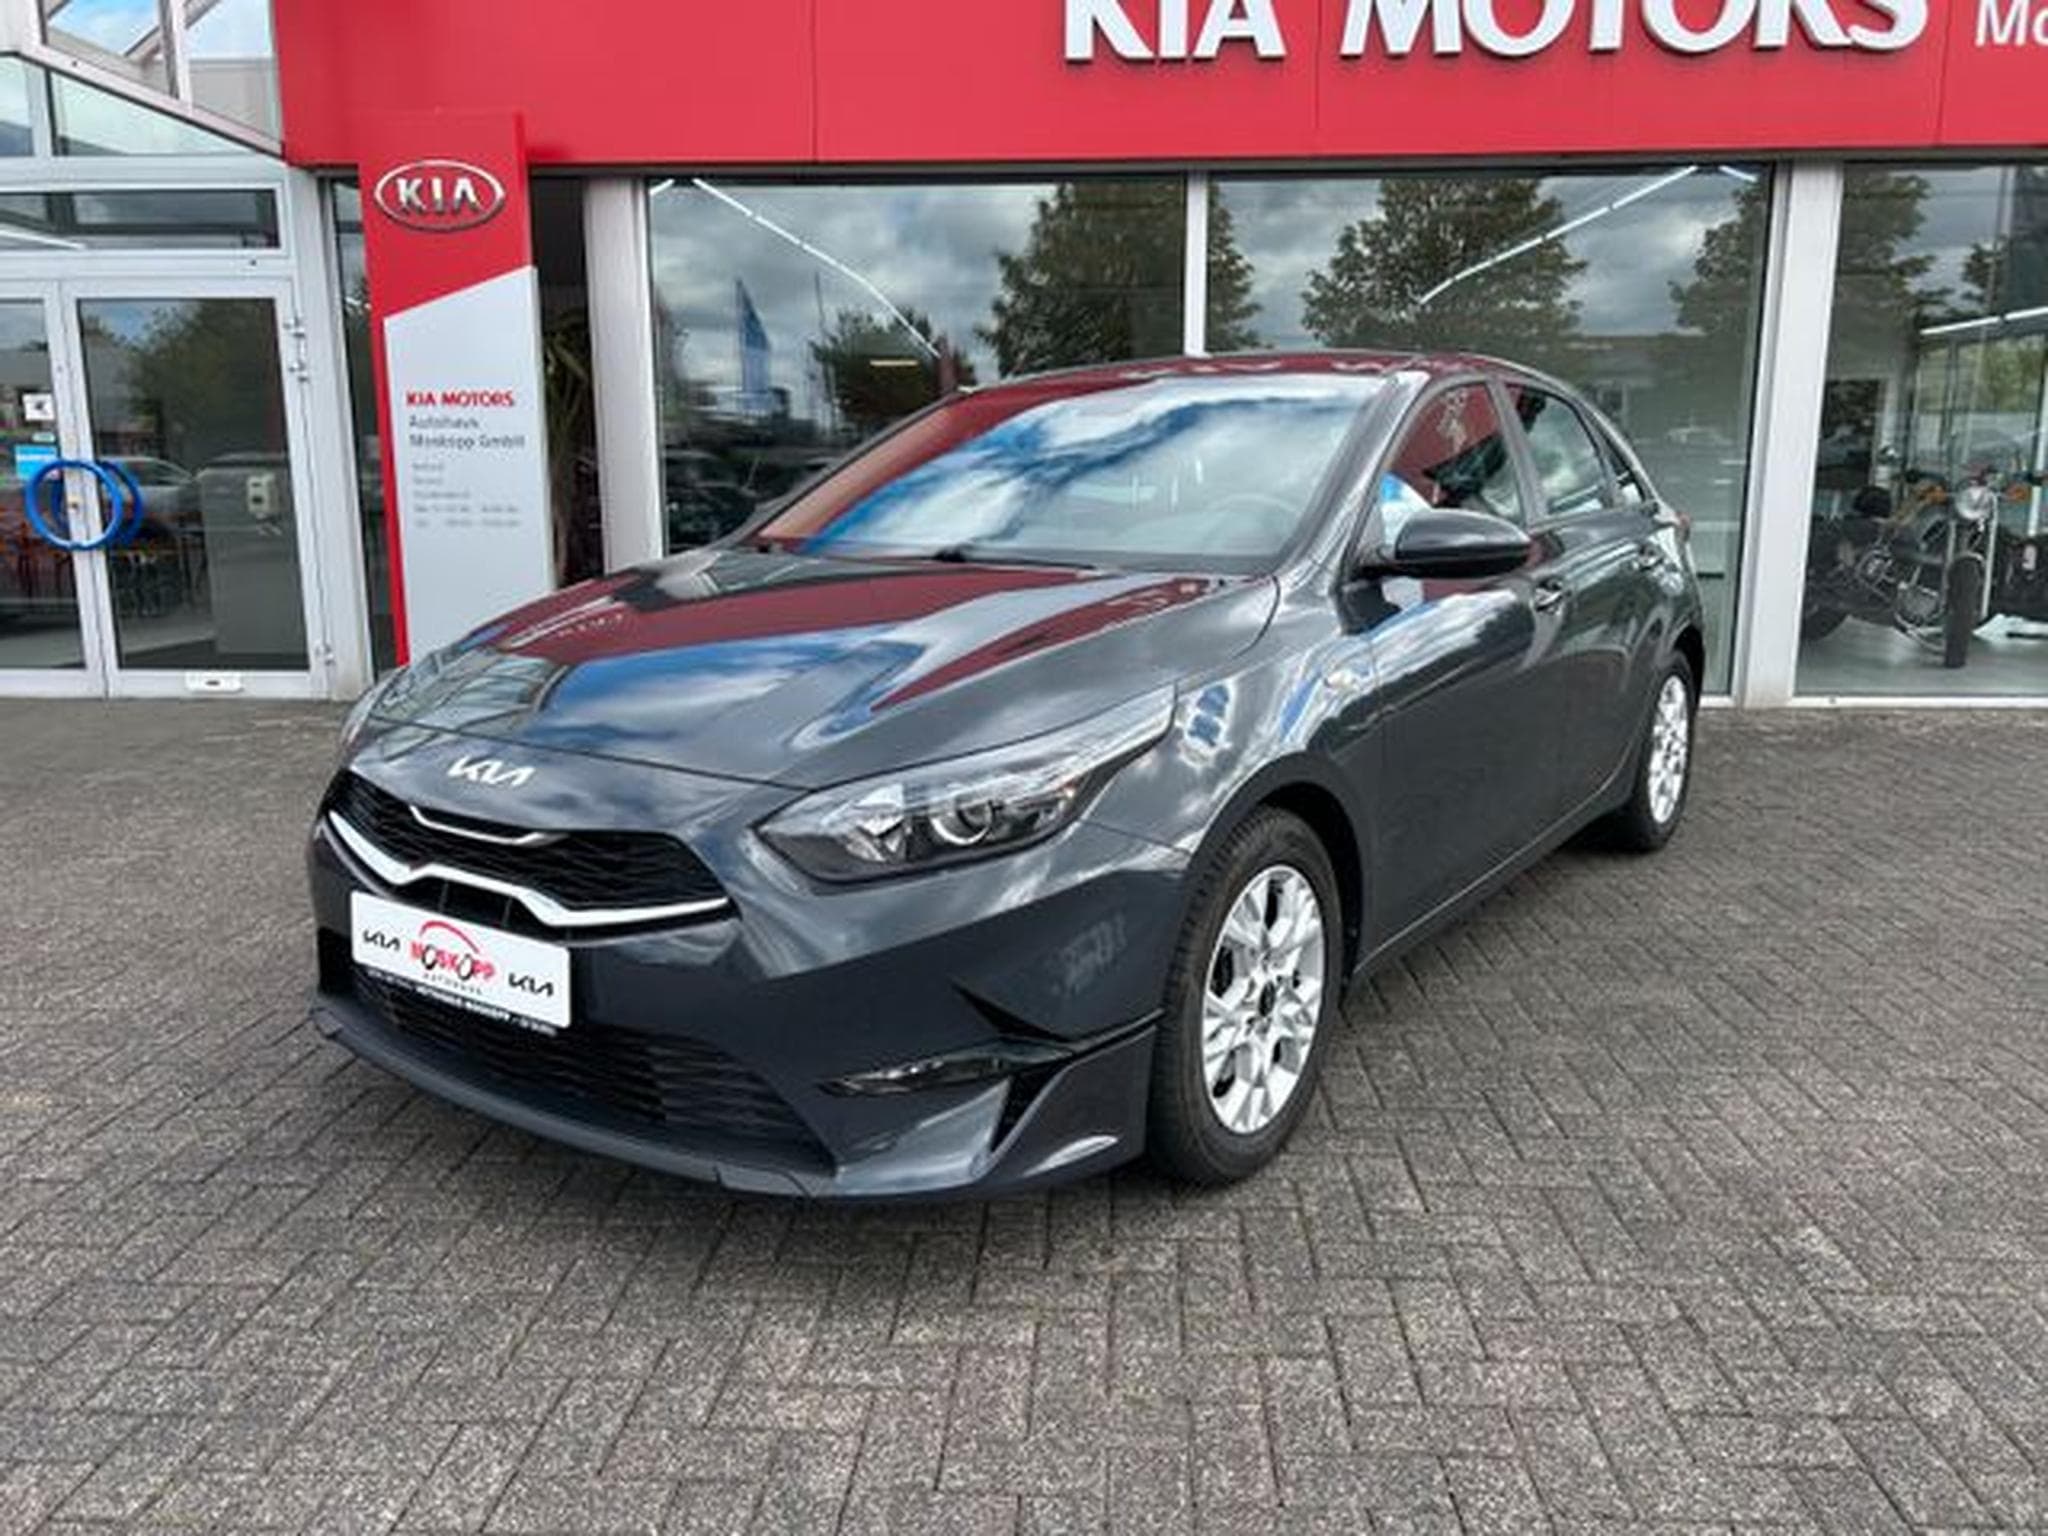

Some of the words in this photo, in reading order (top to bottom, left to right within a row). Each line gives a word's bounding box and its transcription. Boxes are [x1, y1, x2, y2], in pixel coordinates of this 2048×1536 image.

[396, 176, 482, 216] KIA
[406, 391, 436, 406] KIA
[441, 390, 514, 407] MOTORS
[447, 754, 535, 787] KIA
[362, 929, 400, 952] KIA
[507, 971, 555, 998] KIA
